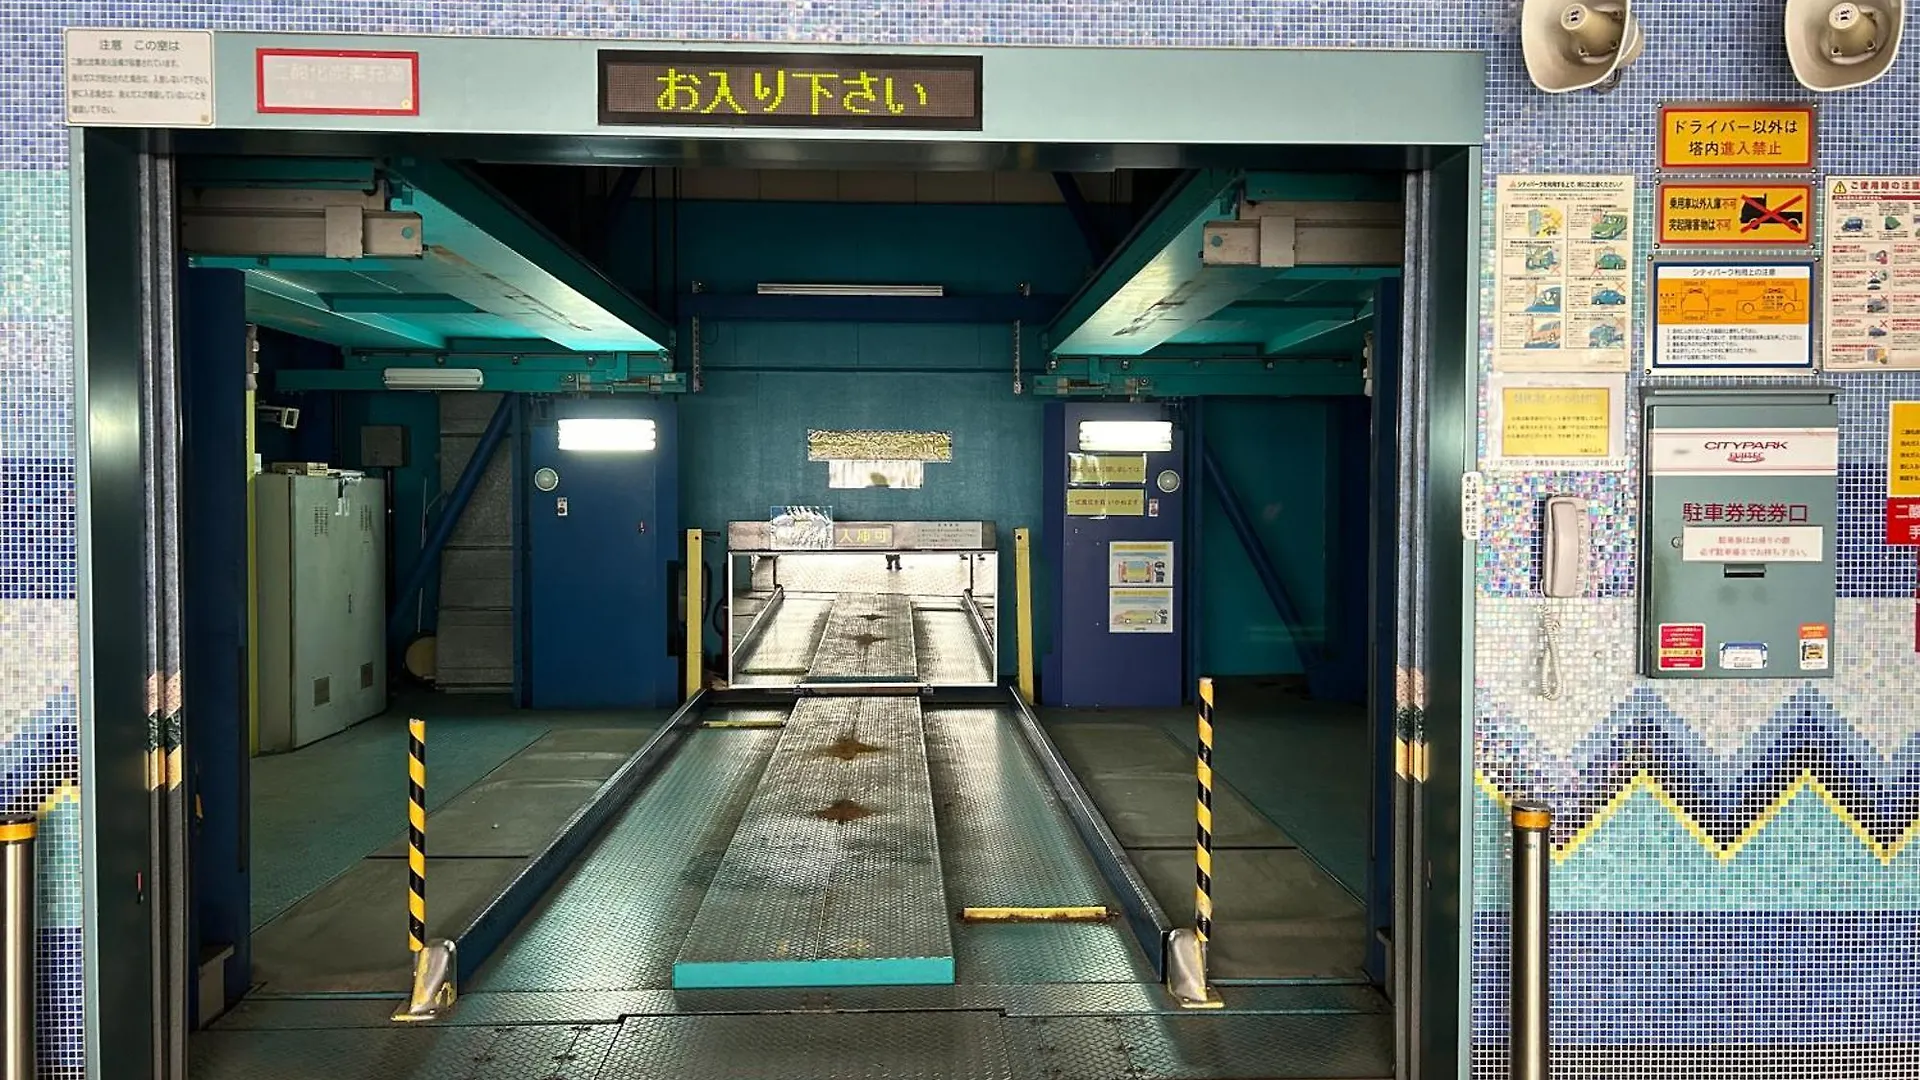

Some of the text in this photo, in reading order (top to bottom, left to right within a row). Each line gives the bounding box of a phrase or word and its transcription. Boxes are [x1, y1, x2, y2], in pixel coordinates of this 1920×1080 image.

[100, 39, 122, 52] 注意
[656, 67, 928, 115] お入り下さい
[1673, 118, 1798, 135] ドライバー以外は
[1688, 140, 1783, 157] 塔内進入禁止
[1669, 196, 1737, 210] 乗用車以外入庫不可
[1668, 218, 1731, 232] 突起障害物は不可
[1704, 441, 1789, 450] CITYPARK
[1682, 502, 1808, 523] 駐車券発券口
[839, 528, 889, 543] 入庫可
